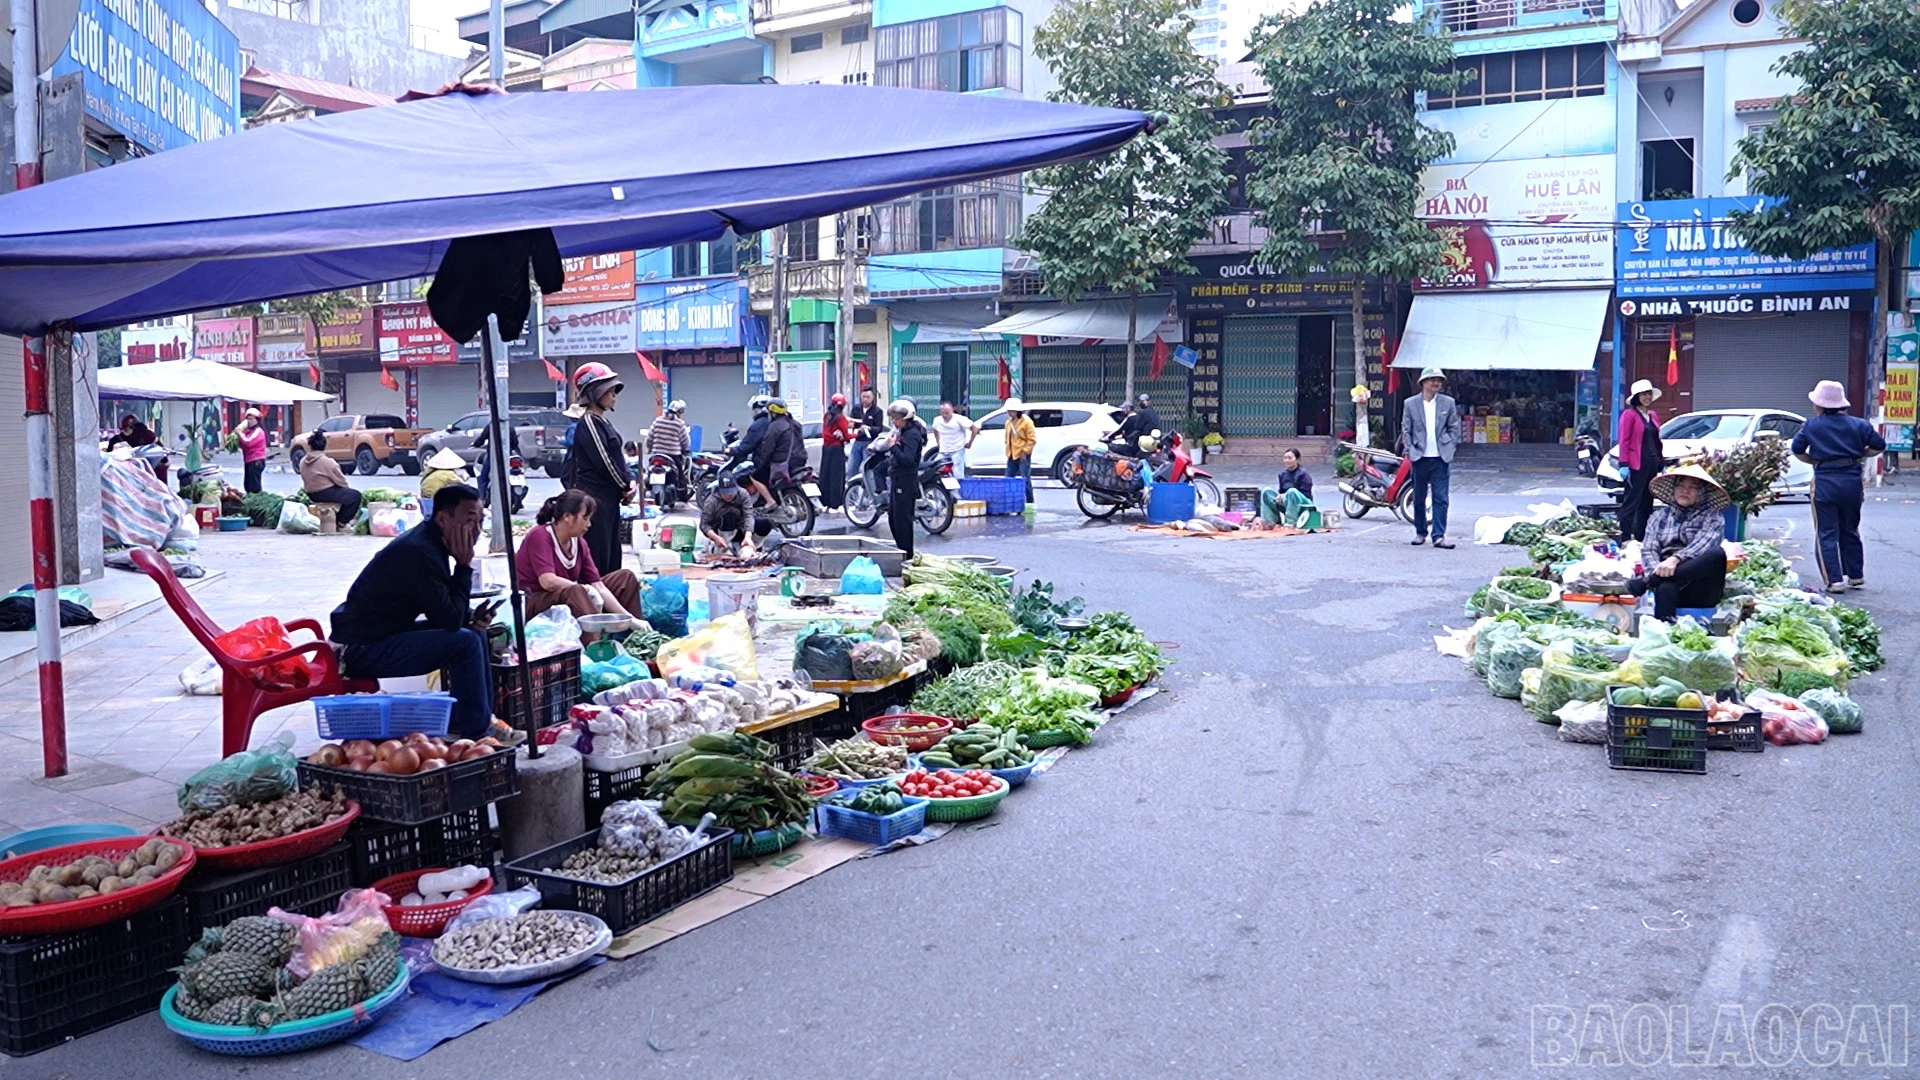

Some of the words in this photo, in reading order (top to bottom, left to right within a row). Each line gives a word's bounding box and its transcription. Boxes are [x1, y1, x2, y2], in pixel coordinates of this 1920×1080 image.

[136, 53, 157, 113] DÂY
[160, 74, 175, 125] CU
[213, 56, 233, 113] LOẠI
[1446, 178, 1468, 191] BIA
[1525, 179, 1560, 200] HUỆ
[1566, 178, 1602, 196] LÂN
[1425, 193, 1450, 216] HÀ
[1455, 192, 1489, 218] NỘI
[1665, 208, 1707, 252] NHÀ
[592, 253, 621, 270] LINH
[1219, 260, 1255, 278] QUỐC
[641, 302, 666, 332] ĐỒNG
[687, 301, 711, 330] KÍNH
[712, 295, 735, 328] MẮT
[1641, 297, 1682, 315] NHÀ
[1687, 294, 1754, 314] THUỐC
[1761, 295, 1813, 312] BÌNH
[1818, 296, 1850, 311] AN
[225, 323, 251, 348] MẮT
